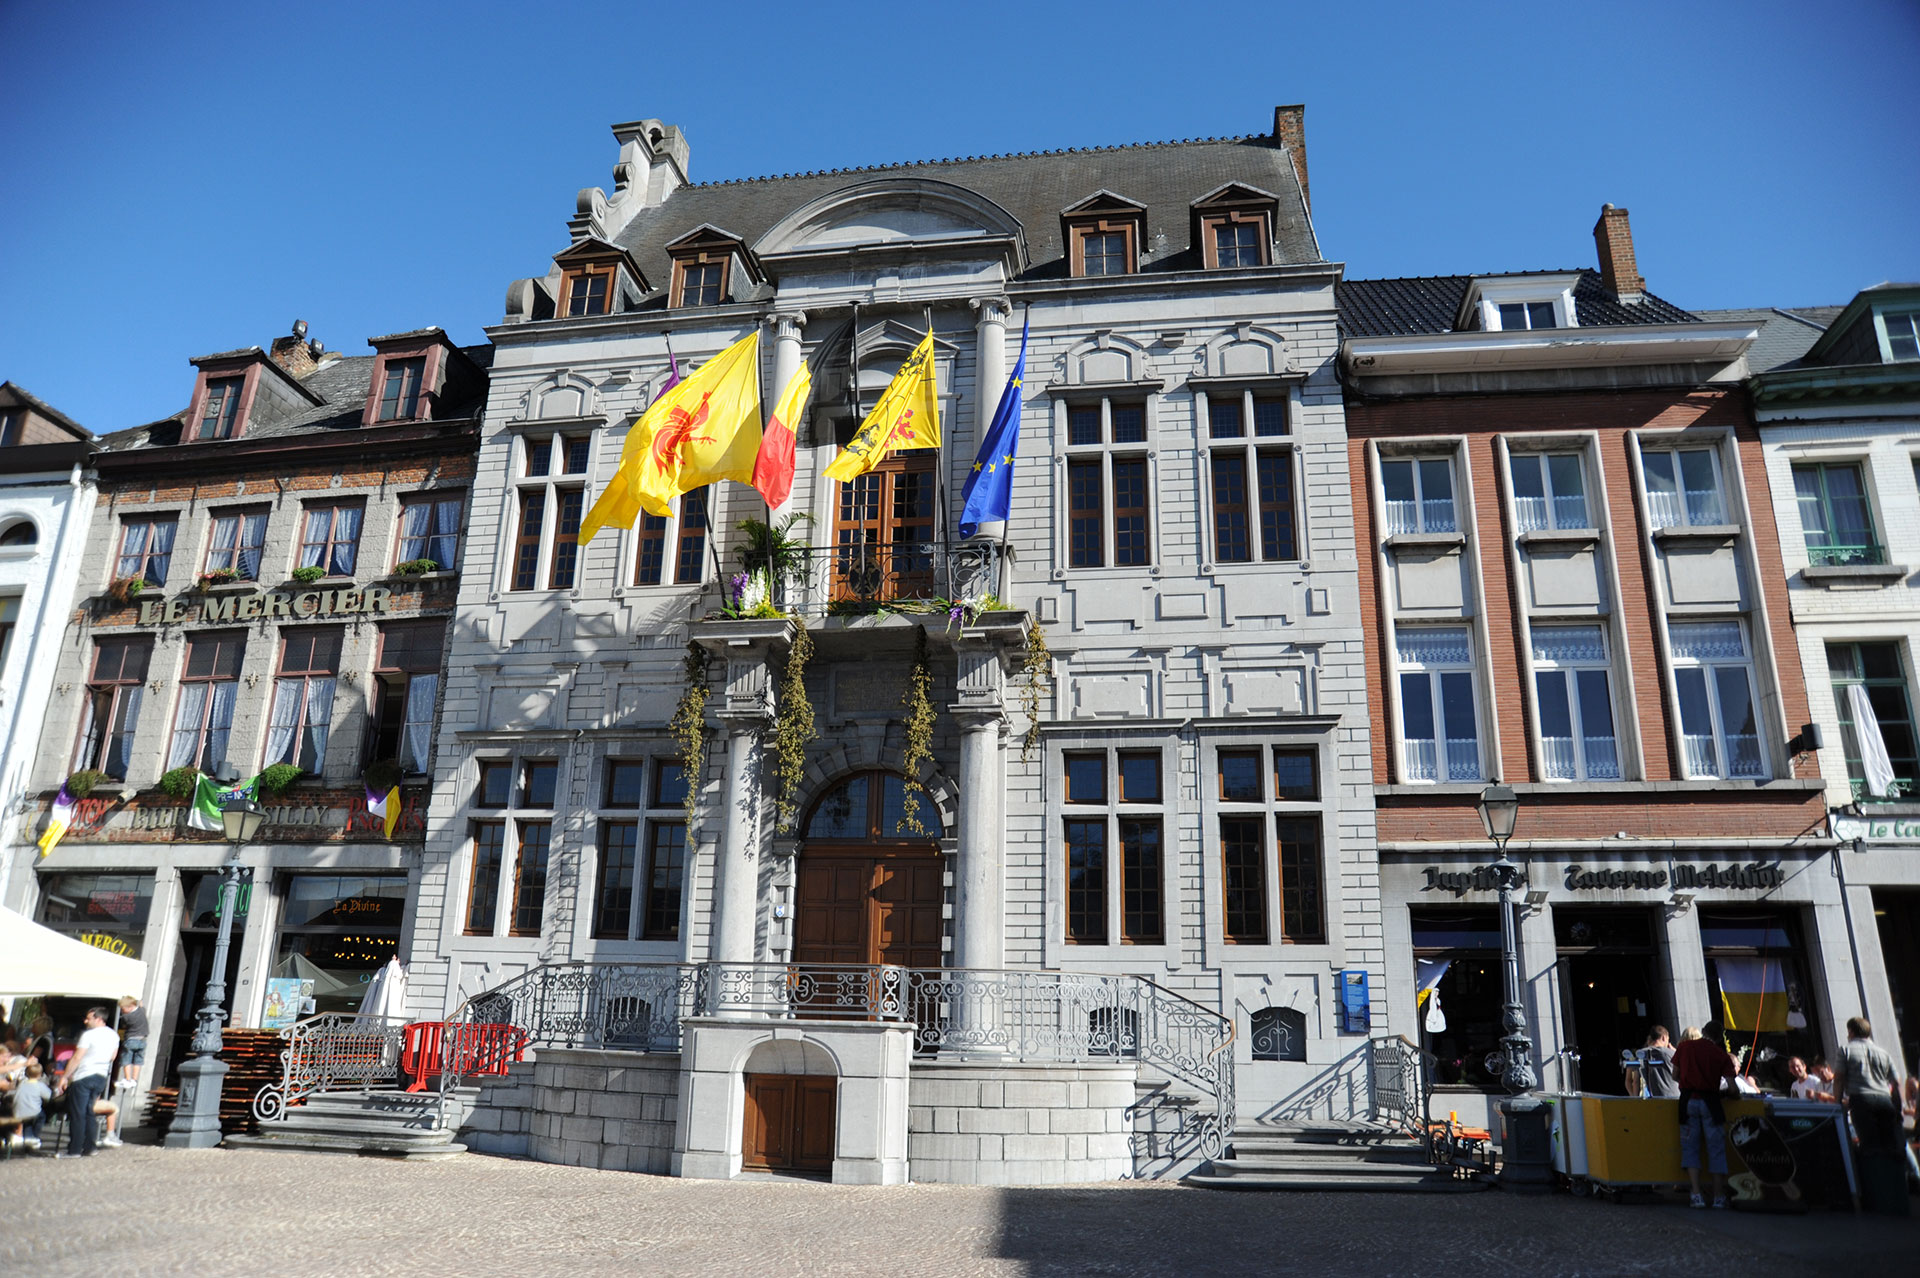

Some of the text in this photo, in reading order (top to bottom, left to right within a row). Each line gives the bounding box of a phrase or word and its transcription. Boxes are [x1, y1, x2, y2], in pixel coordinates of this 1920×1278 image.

[138, 587, 391, 625] LE MERCIER
[70, 798, 108, 824] OTCH
[261, 805, 328, 826] SILLY
[1869, 820, 1888, 838] Le
[1420, 866, 1528, 899] Jupilr
[1564, 863, 1784, 891] Taverne Melchior
[333, 898, 381, 914] La Divine
[81, 934, 140, 960] MERCIE
